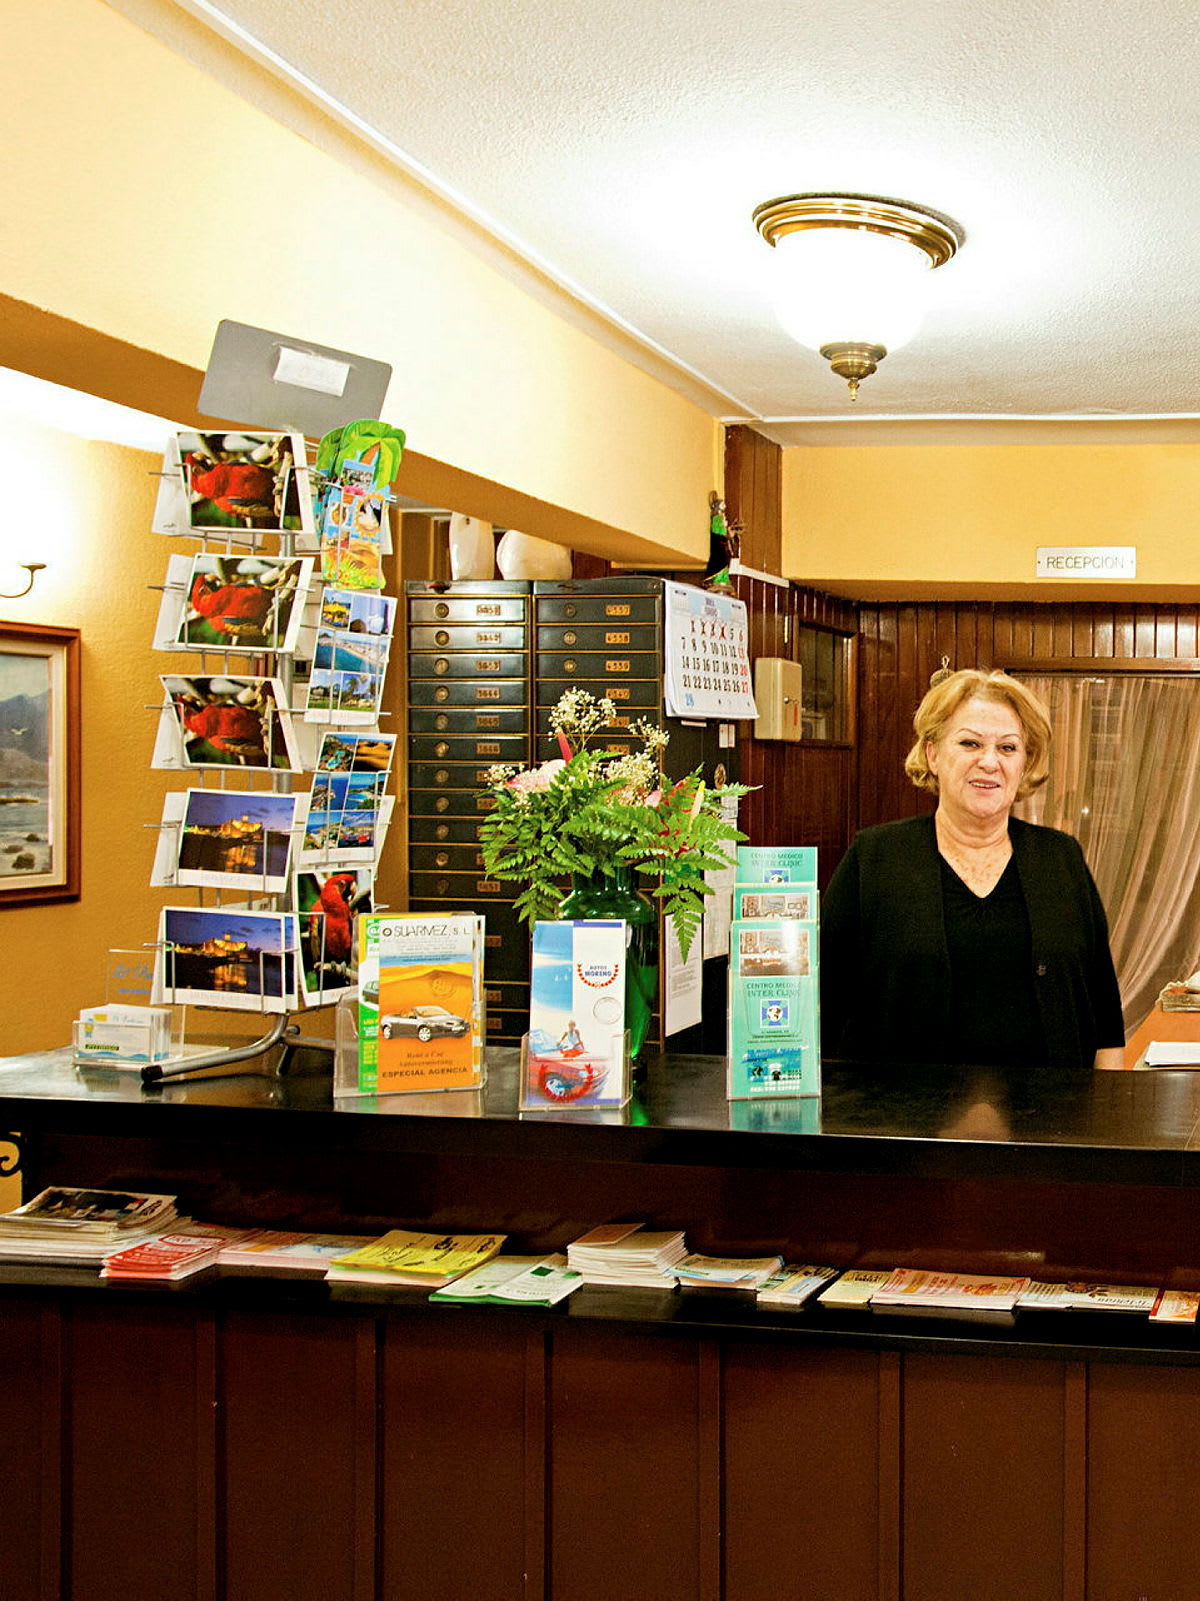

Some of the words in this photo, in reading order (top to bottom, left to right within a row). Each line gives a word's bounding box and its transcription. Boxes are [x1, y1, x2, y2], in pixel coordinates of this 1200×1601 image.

[1046, 555, 1124, 569] RECEPCION
[681, 636, 686, 650] 7
[691, 638, 697, 652] 8
[702, 639, 707, 653] 9
[710, 641, 719, 655] 10
[720, 643, 727, 657] 11
[729, 644, 737, 658] 12
[682, 655, 690, 669] 14
[692, 657, 701, 671] 15
[703, 658, 710, 672] 16
[712, 659, 719, 673] 17
[722, 660, 730, 674] 18
[731, 662, 739, 676] 19
[740, 663, 748, 677] 20
[683, 674, 691, 688] 21
[693, 675, 702, 689] 22
[703, 677, 711, 690] 23
[713, 678, 721, 691] 24
[723, 679, 731, 692] 25
[732, 680, 740, 693] 26
[741, 681, 748, 694] 27
[746, 982, 774, 990] CENTRO
[747, 989, 774, 997] INTER
[382, 1070, 425, 1078] ESPECIAL
[428, 1067, 468, 1076] AGENCIA
